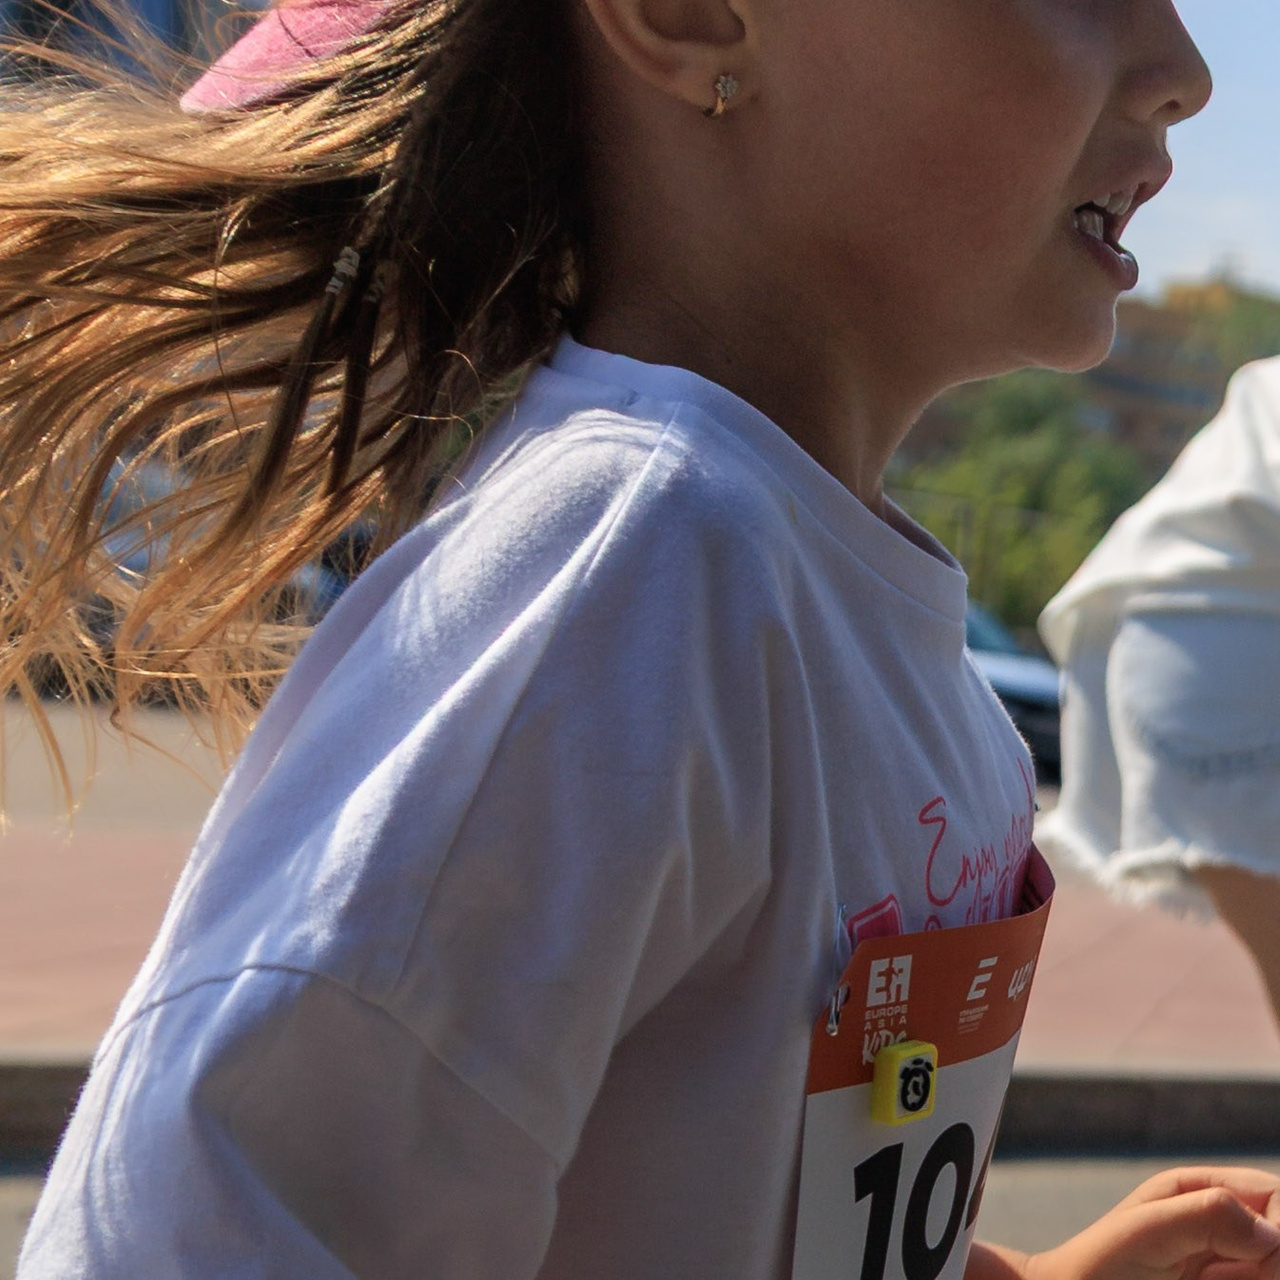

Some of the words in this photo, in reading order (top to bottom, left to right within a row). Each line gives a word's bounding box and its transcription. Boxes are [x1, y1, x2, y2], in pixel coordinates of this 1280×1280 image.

[918, 795, 1000, 915] Enjoy
[865, 1004, 909, 1020] EUROPE
[864, 1015, 907, 1031] ASIA
